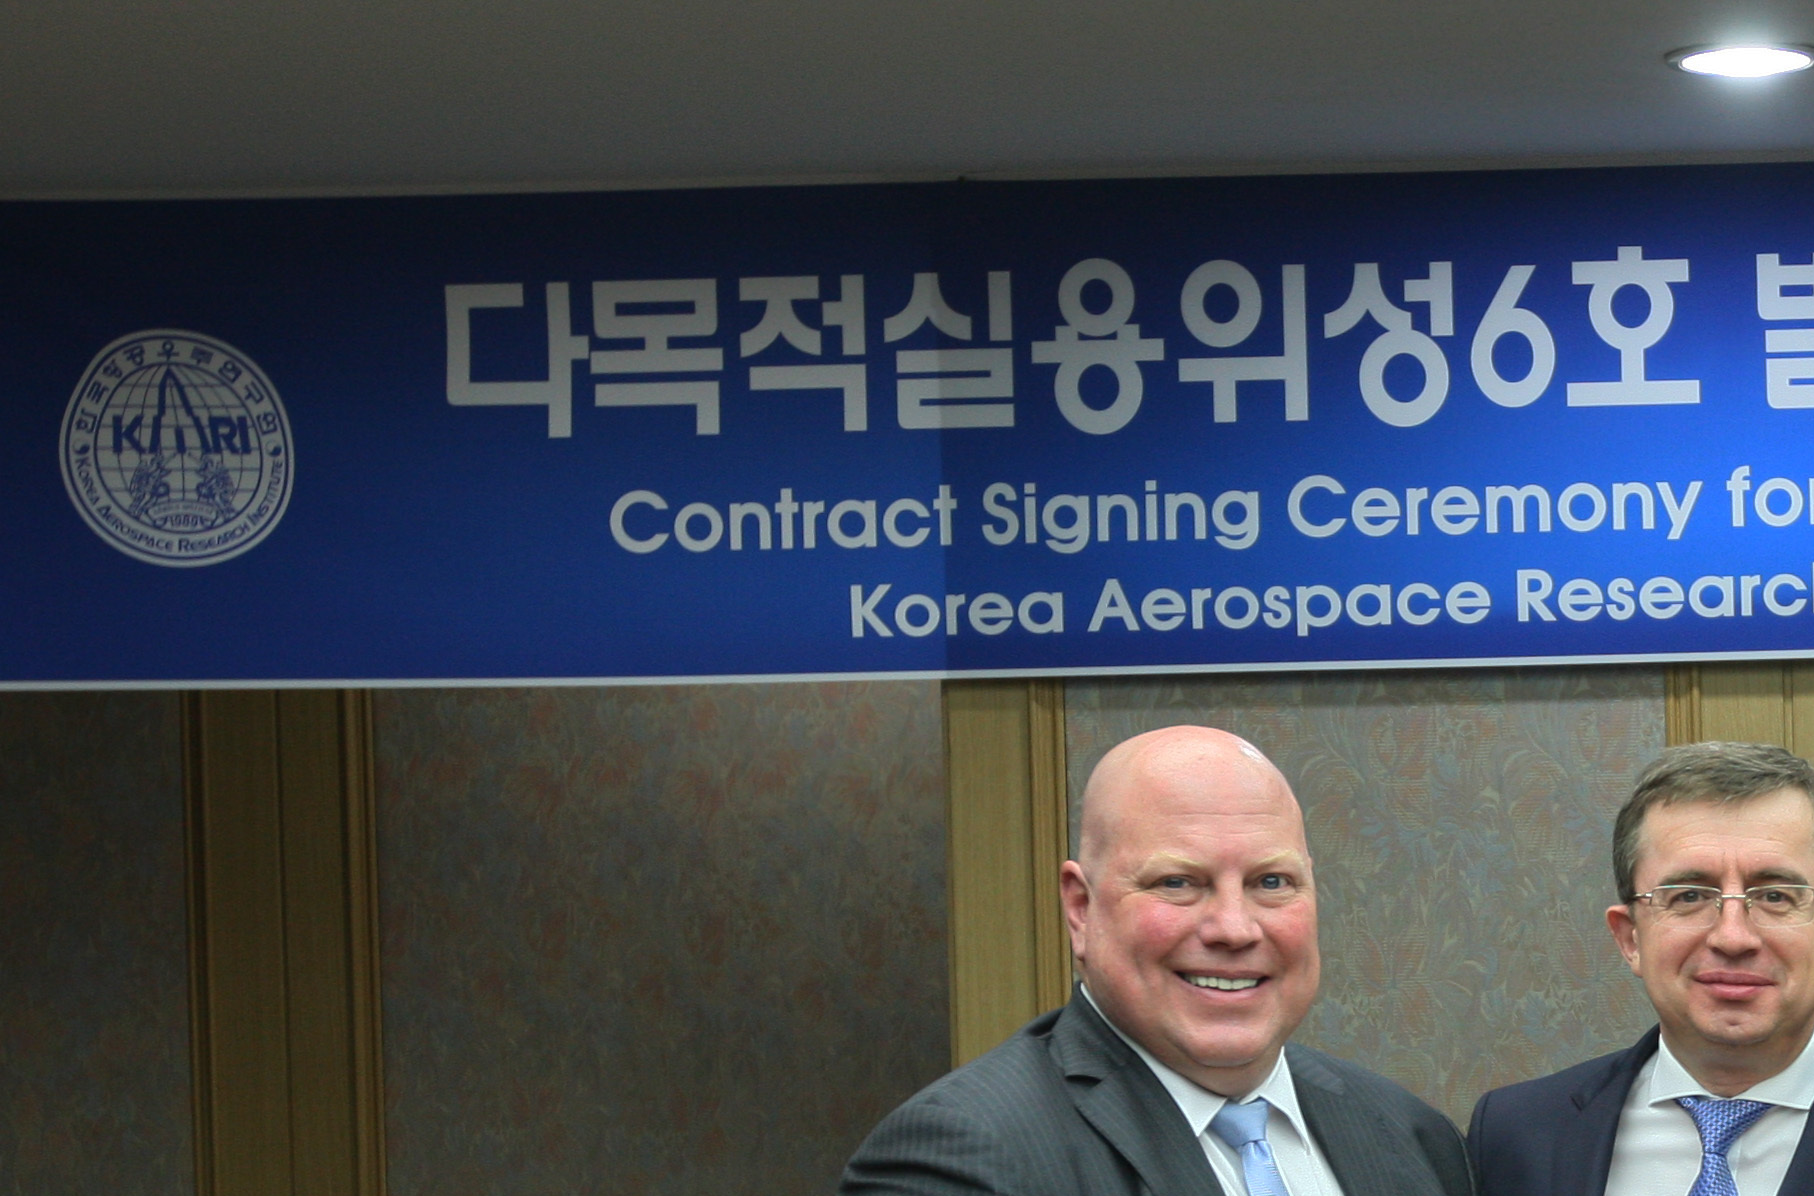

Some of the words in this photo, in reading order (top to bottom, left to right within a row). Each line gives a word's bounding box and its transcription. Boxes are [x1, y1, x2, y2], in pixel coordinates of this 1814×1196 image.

[444, 245, 1702, 439] 다목적실용위성6호
[112, 367, 252, 455] KARI
[609, 484, 958, 555] Contract
[981, 479, 1261, 555] Signing
[1286, 474, 1704, 541] Ceremony
[849, 583, 1065, 639] Korea
[1086, 578, 1492, 637] Aerospace
